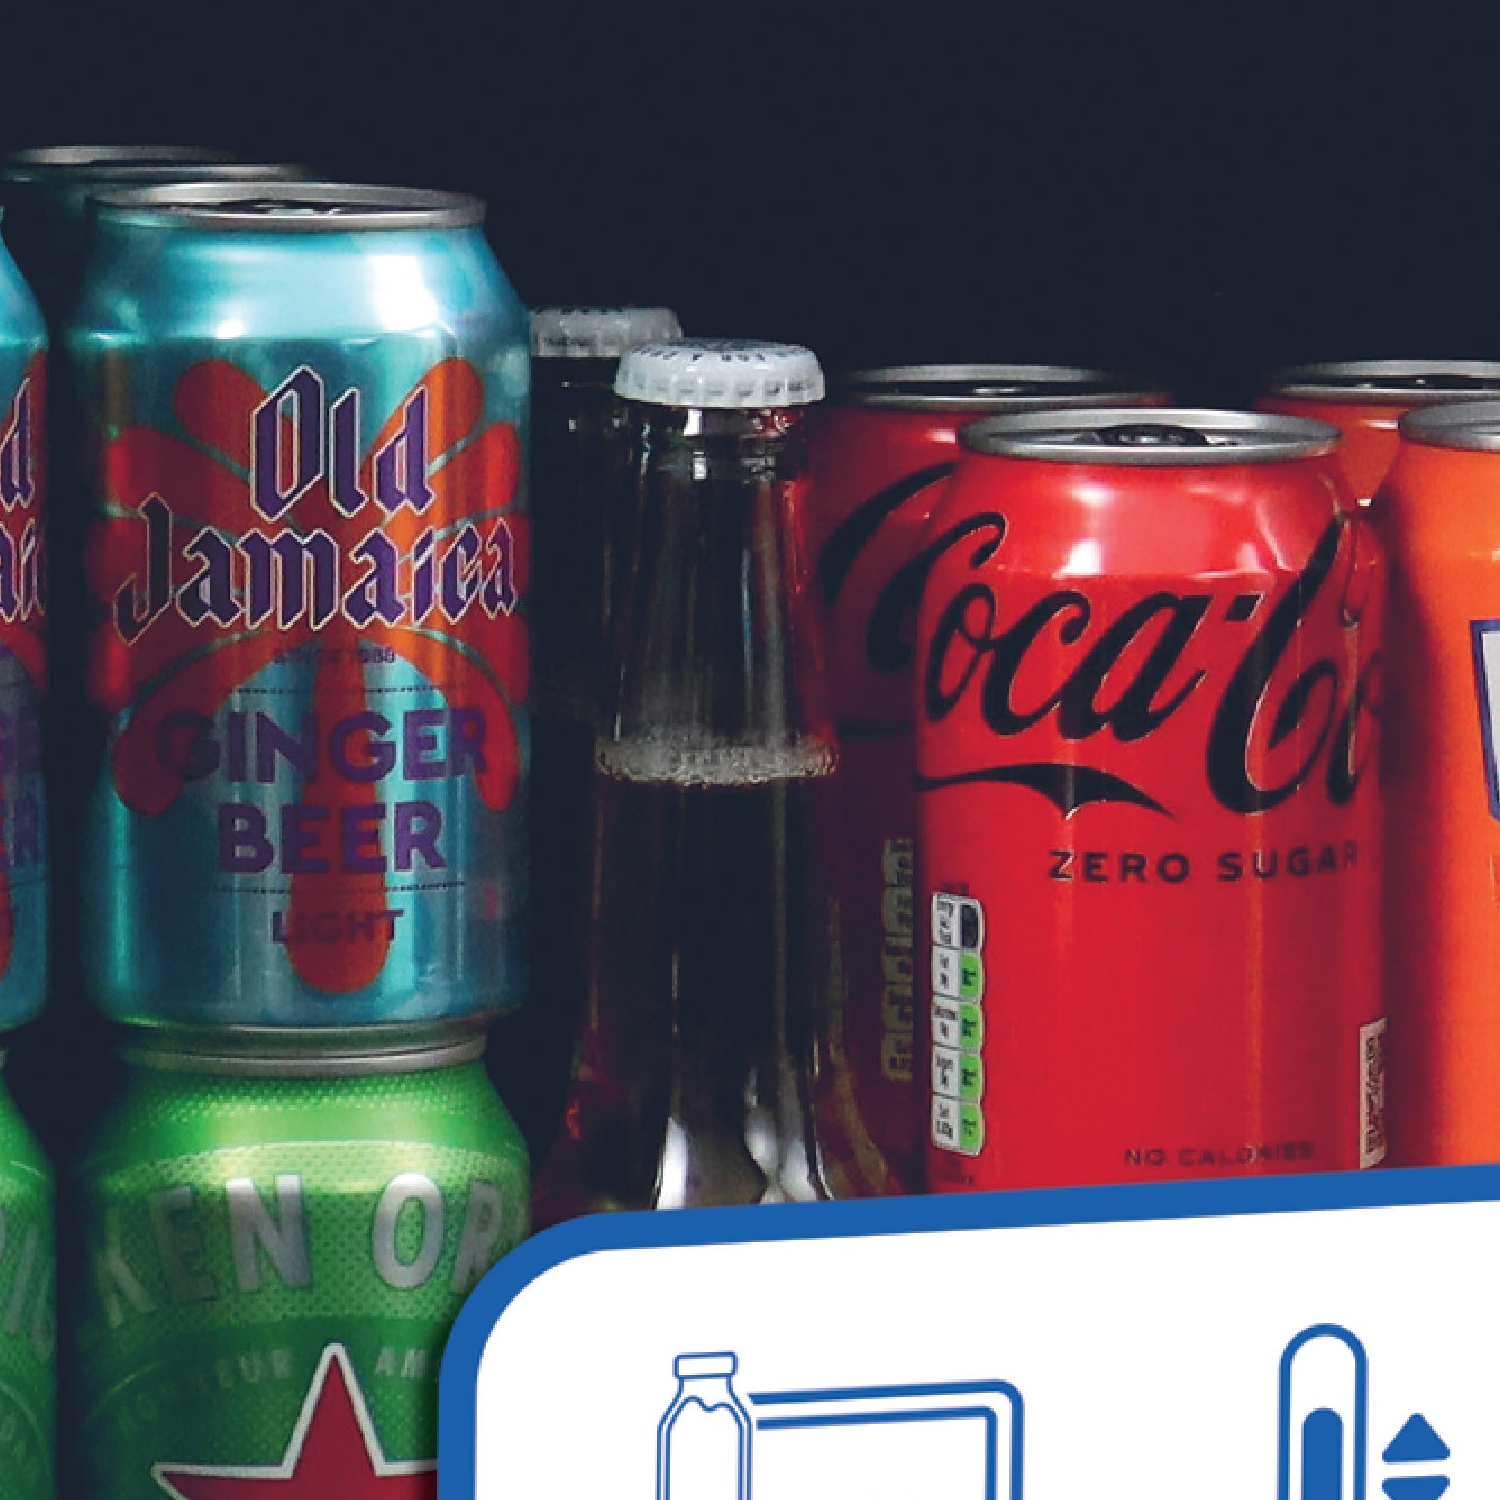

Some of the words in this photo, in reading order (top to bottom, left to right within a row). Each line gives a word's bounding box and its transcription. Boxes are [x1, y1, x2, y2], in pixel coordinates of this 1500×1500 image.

[250, 364, 437, 523] Old
[112, 491, 518, 647] Jamaica
[157, 707, 489, 785] GINGER
[218, 801, 447, 873] BEER
[1048, 850, 1190, 884] ZERO
[1217, 841, 1358, 882] SUGAR
[271, 908, 404, 945] LIGHT
